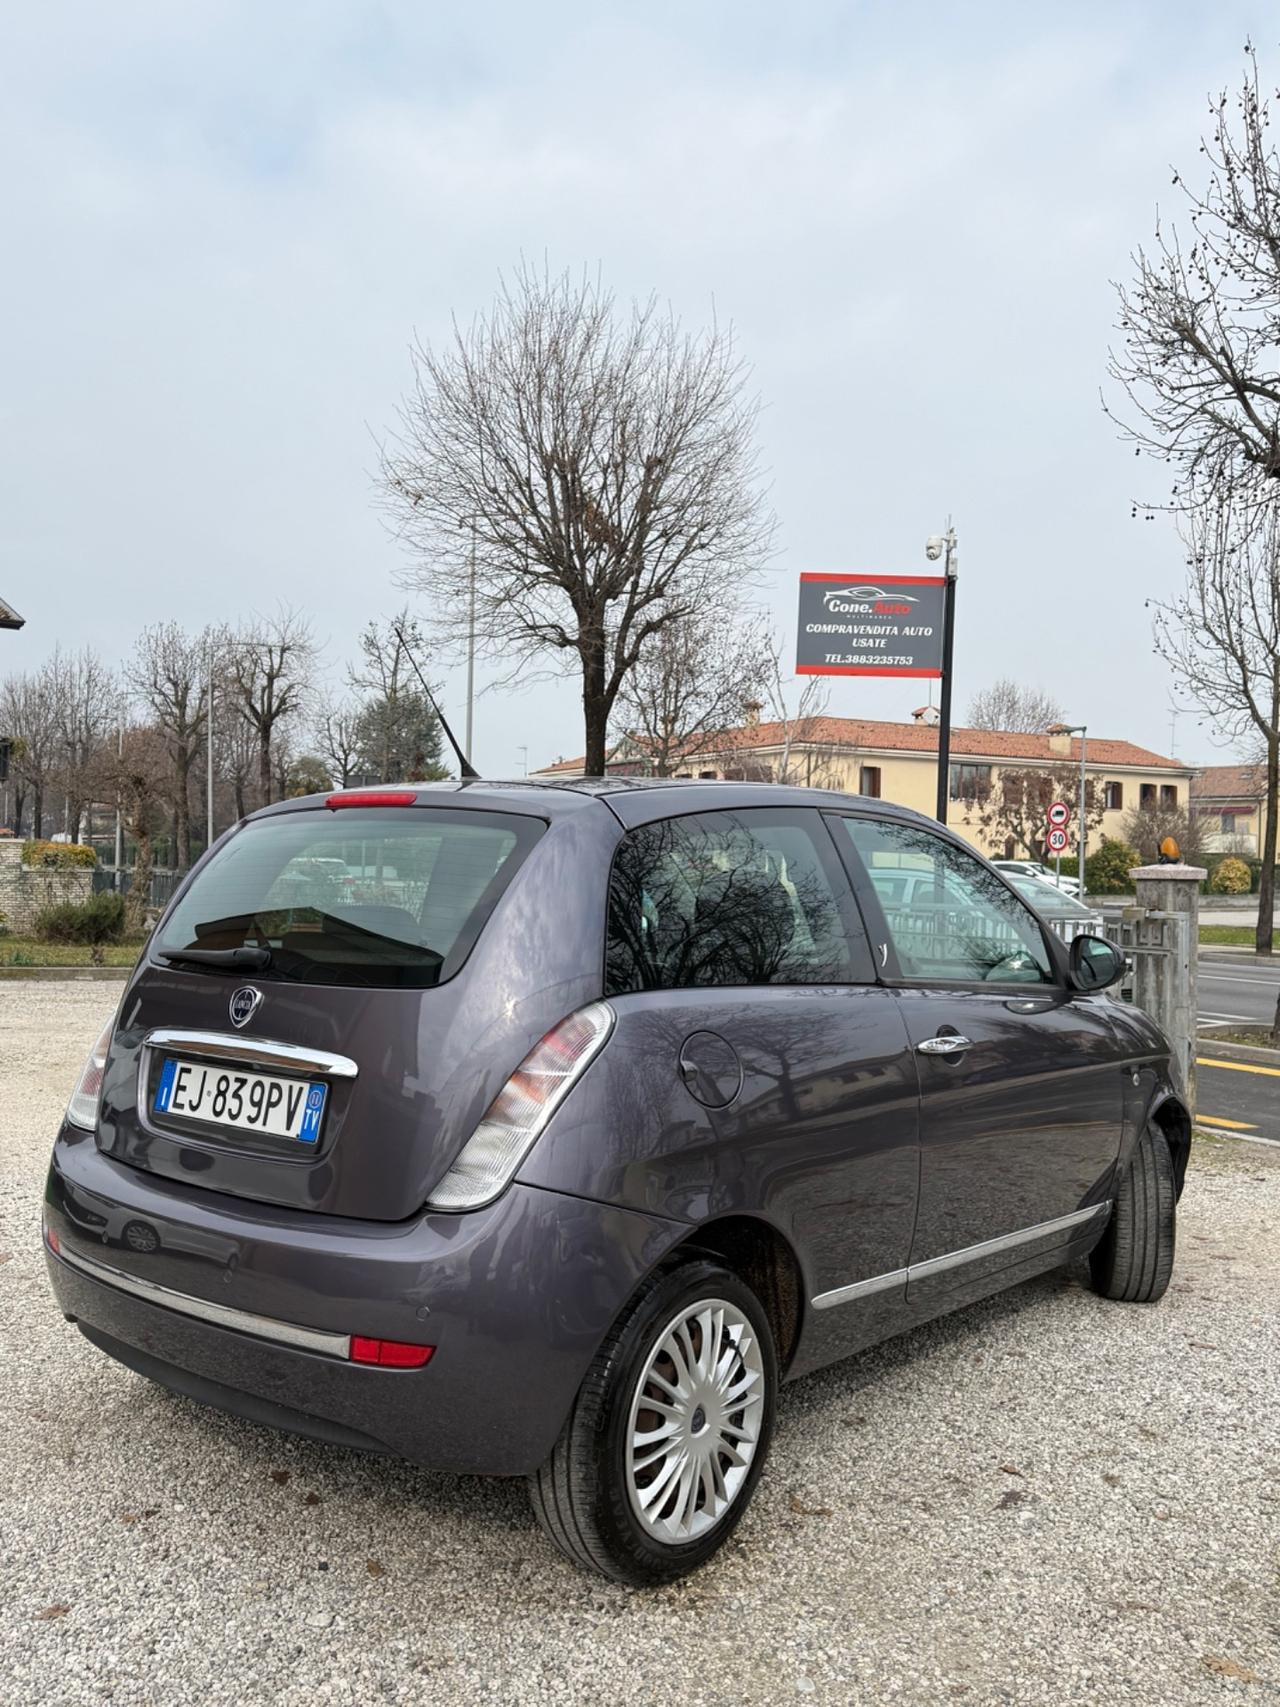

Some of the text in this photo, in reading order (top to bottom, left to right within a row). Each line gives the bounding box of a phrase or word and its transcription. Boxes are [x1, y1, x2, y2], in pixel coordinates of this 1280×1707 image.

[806, 623, 933, 636] COMPRAVENDITA AUTO
[852, 638, 887, 648] USATE
[1052, 833, 1064, 845] 30
[303, 1108, 320, 1131] TV
